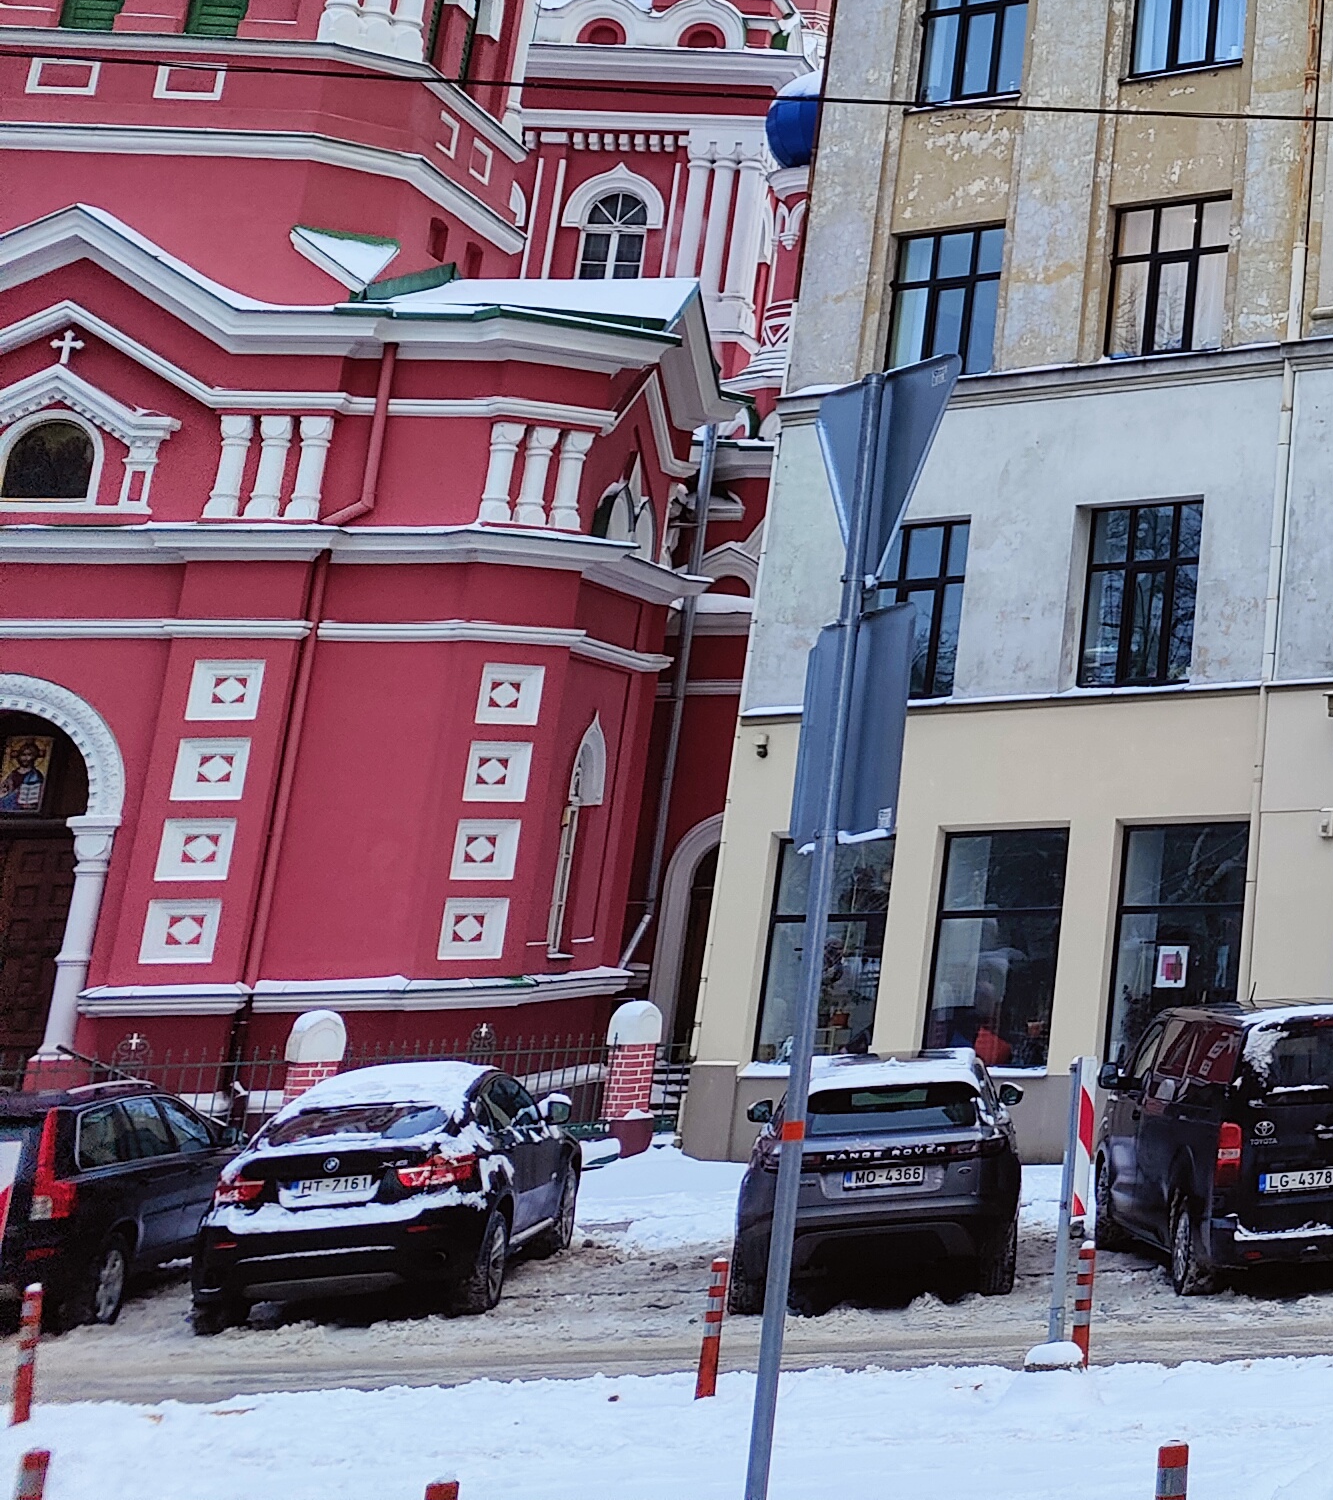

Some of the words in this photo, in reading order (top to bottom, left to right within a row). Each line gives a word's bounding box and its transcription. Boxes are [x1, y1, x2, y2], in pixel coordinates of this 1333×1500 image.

[1250, 1137, 1278, 1146] TOYOTA
[825, 1150, 883, 1161] RANGE
[891, 1145, 947, 1157] ROVER
[854, 1166, 921, 1184] MO-4366
[1268, 1170, 1333, 1189] LG-4378
[301, 1176, 368, 1194] HT-7161
